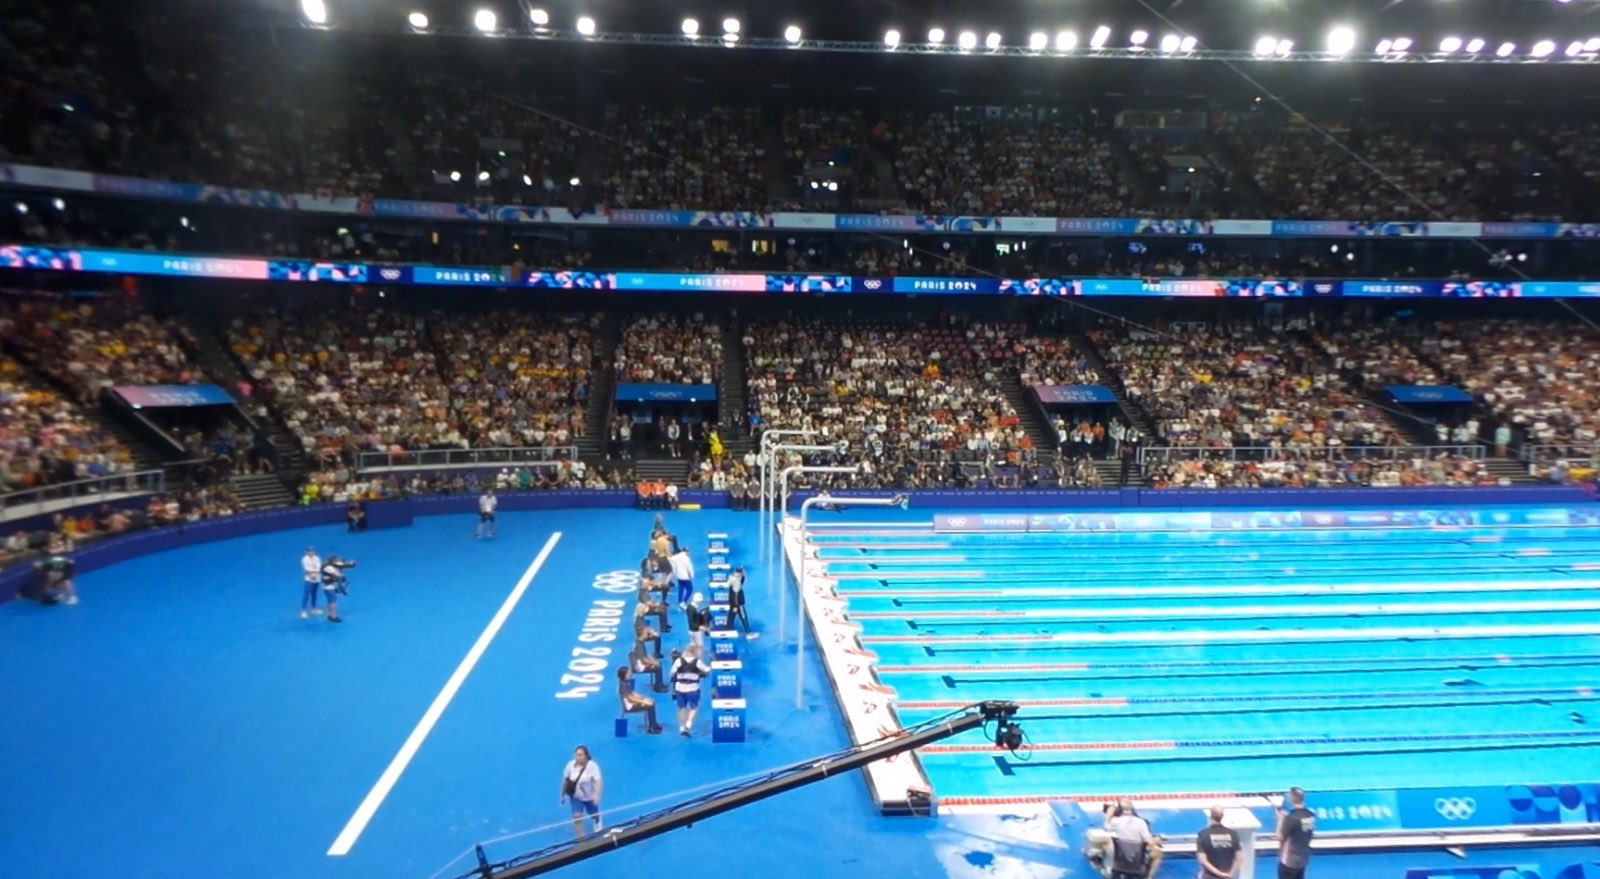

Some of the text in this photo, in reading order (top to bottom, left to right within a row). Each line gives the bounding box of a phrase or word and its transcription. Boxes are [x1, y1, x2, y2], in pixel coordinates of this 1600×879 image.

[436, 271, 471, 281] PARIS
[680, 278, 713, 287] PARIS
[914, 281, 977, 290] PARIS 2024
[554, 647, 612, 698] 2024
